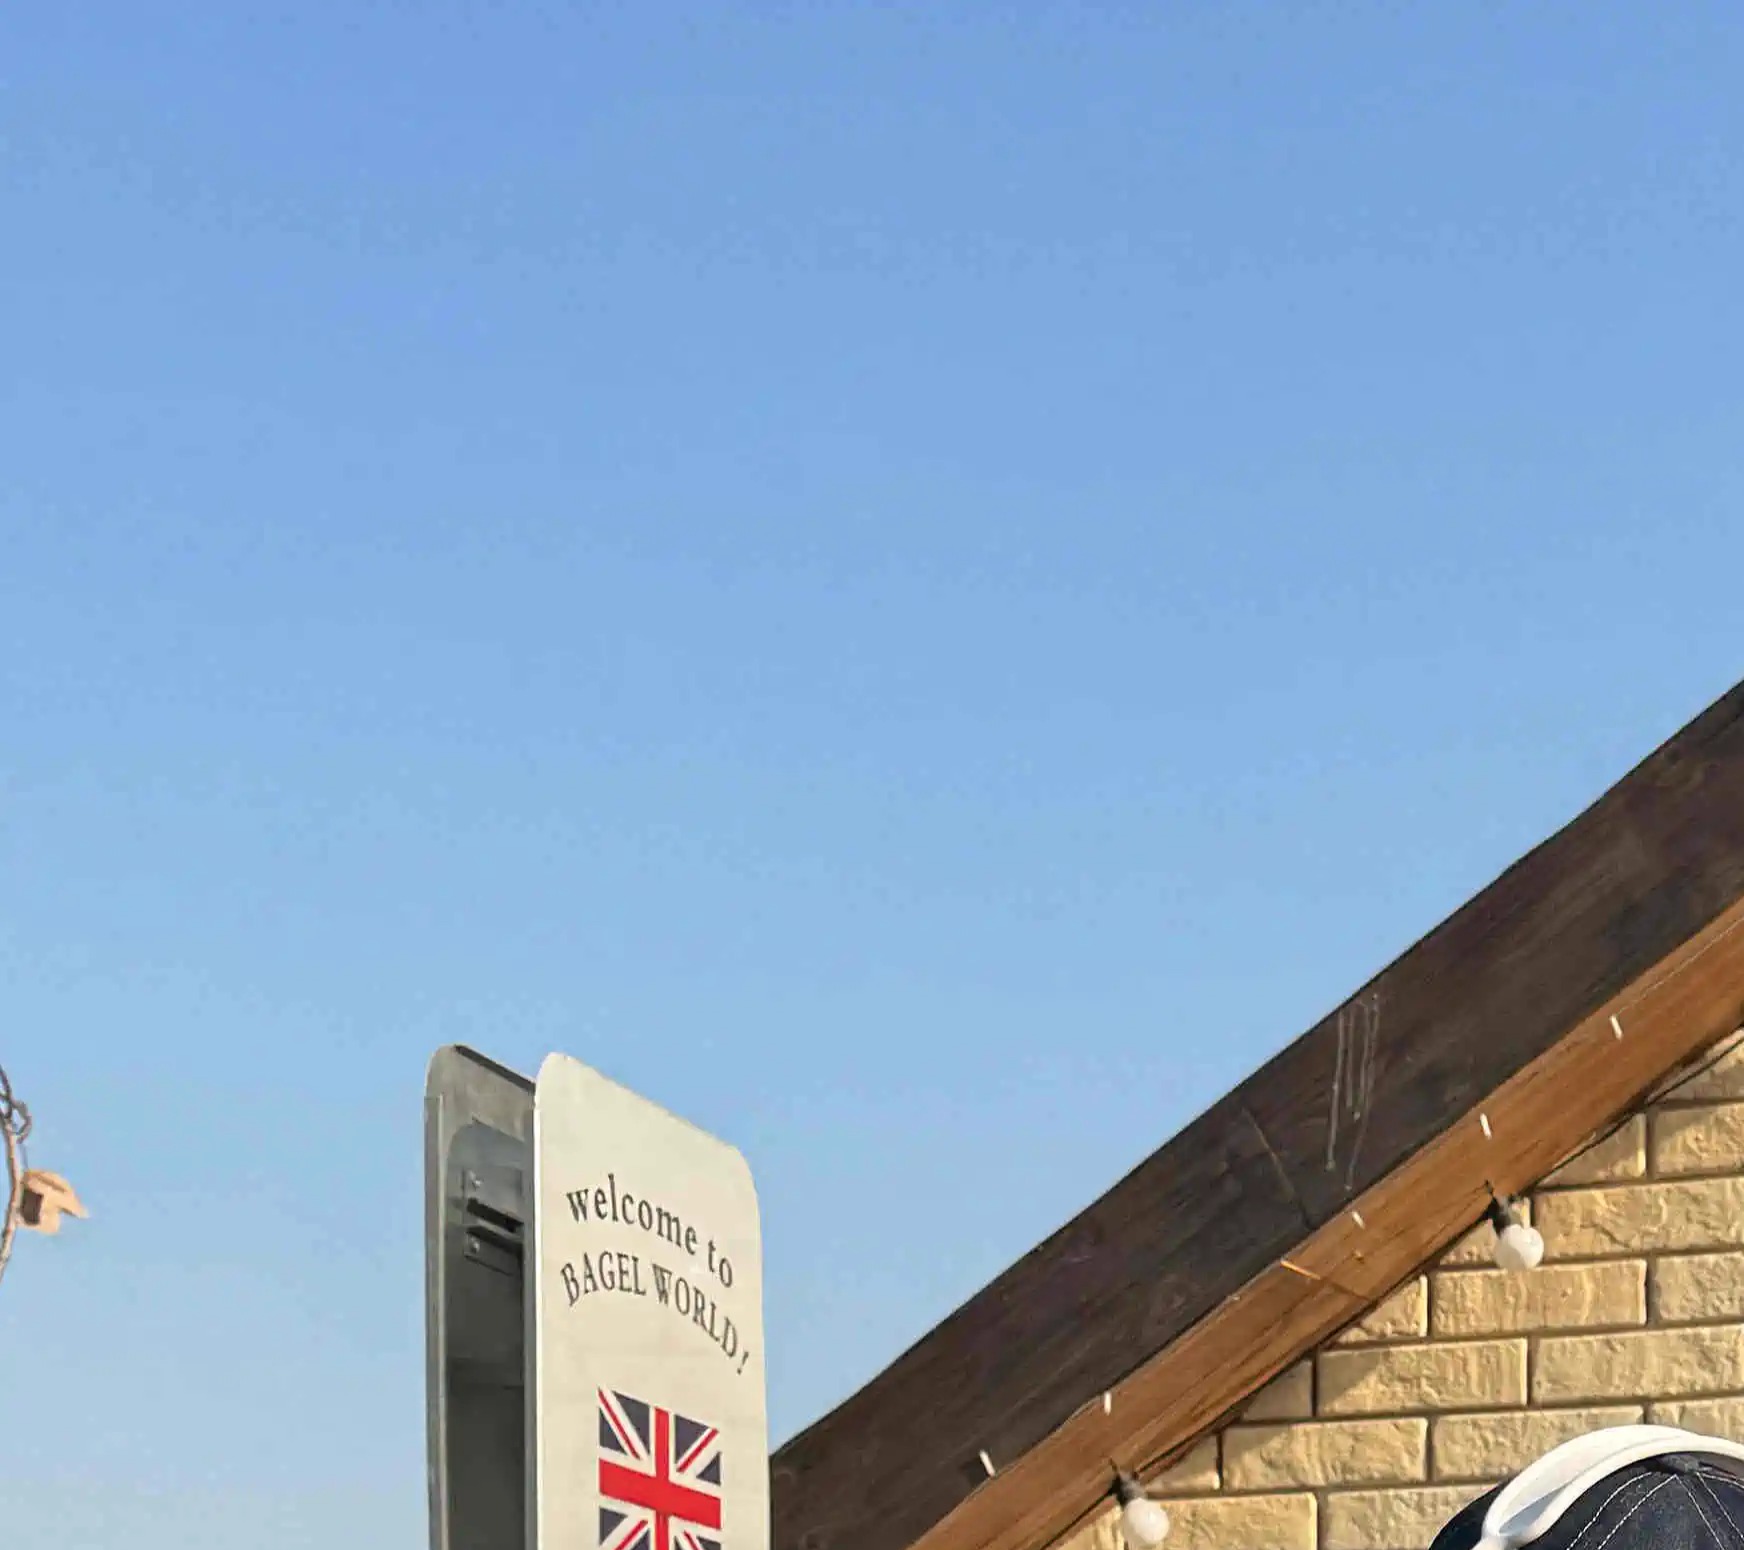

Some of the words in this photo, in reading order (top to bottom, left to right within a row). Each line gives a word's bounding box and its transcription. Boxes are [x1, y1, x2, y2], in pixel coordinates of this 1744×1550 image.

[566, 1173, 697, 1255] welcome
[706, 1239, 733, 1289] to
[560, 1250, 647, 1308] BAGEL
[651, 1262, 750, 1376] WORLD!
